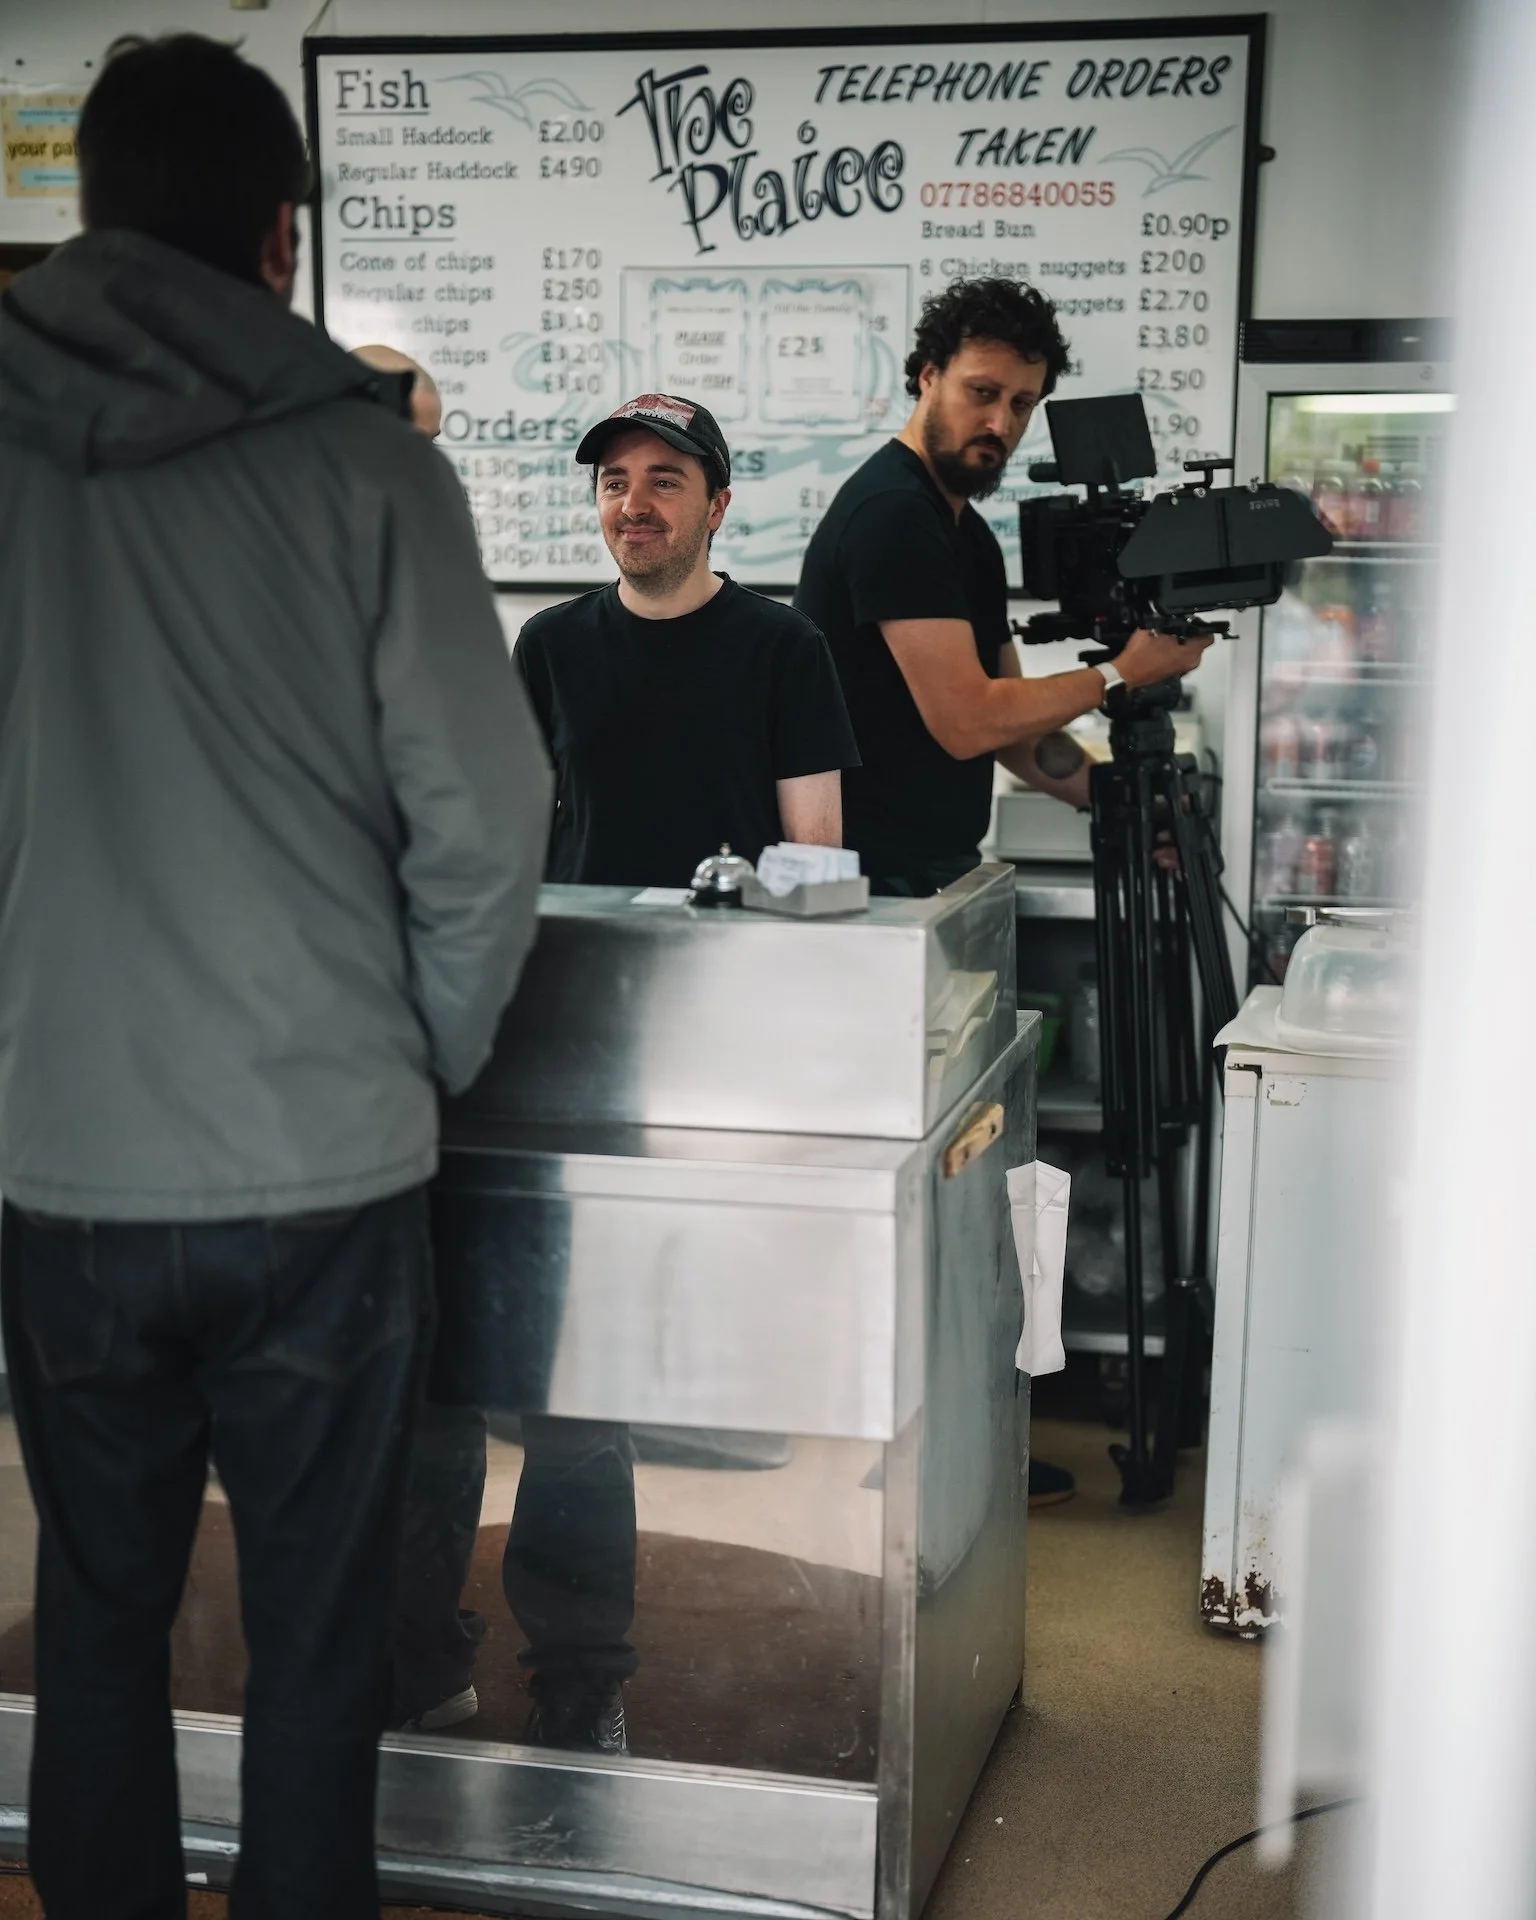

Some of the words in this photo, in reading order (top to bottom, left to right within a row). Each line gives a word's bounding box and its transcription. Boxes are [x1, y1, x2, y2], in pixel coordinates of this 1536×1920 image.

[336, 69, 429, 109] Fish
[814, 60, 1050, 104] TELEPHONE
[1066, 55, 1233, 99] ORDERS
[336, 127, 394, 146] Small
[402, 126, 494, 146] Haddock
[538, 121, 604, 143] £2.00
[615, 65, 756, 182] The
[7, 142, 47, 160] your
[955, 126, 1097, 167] TAKEN
[337, 162, 417, 184] Regular
[427, 161, 518, 181] Haddock
[666, 120, 905, 256] Plaice
[920, 181, 1117, 208] 07786840055
[338, 195, 457, 236] Chips
[921, 220, 985, 239] Bread
[993, 220, 1036, 239] Bun
[1140, 212, 1230, 241] £0.90p
[339, 252, 396, 271] Cone
[404, 251, 427, 271] of
[434, 251, 496, 275] chips
[940, 258, 1030, 276] Chicken
[1039, 259, 1127, 279] nuggets
[434, 281, 496, 305] chips
[1054, 295, 1126, 316] uggets
[1138, 288, 1210, 313] £2.70
[411, 315, 471, 337] chips
[1137, 324, 1210, 349] £3.80
[429, 345, 490, 368] chips
[444, 409, 579, 442] Orders
